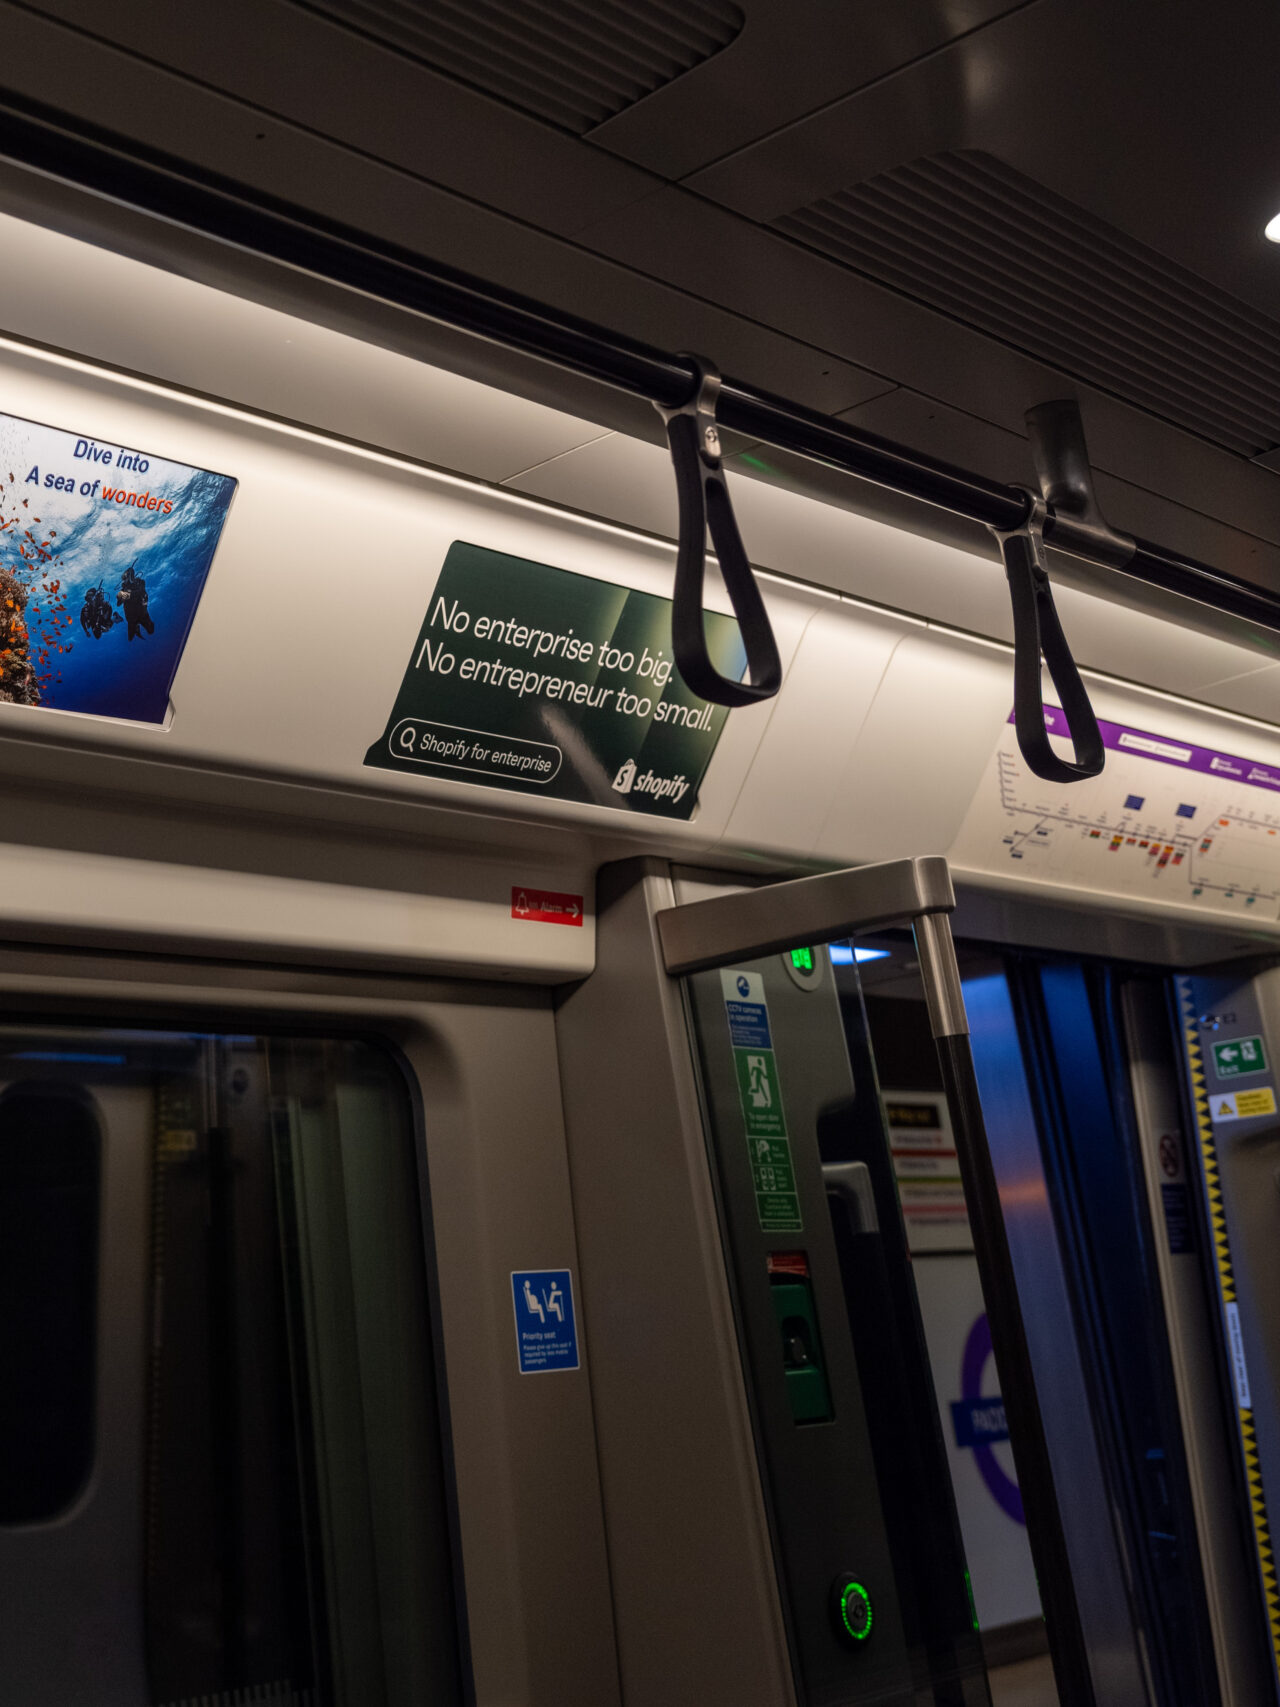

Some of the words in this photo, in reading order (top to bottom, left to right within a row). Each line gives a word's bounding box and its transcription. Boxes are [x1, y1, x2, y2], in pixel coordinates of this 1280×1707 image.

[73, 439, 113, 465] Dive
[116, 449, 150, 473] into
[25, 465, 39, 485] A
[44, 472, 75, 494] sea
[80, 479, 100, 498] of
[102, 485, 174, 515] wonders
[430, 596, 470, 634] No
[473, 616, 594, 663] enterprise
[597, 641, 634, 672] too
[636, 647, 673, 687] big.
[415, 638, 455, 675] No
[459, 657, 614, 709] entrepreneur
[616, 687, 652, 718] too
[654, 700, 714, 732] small.
[420, 733, 470, 760] Shopify
[471, 743, 490, 761] for
[491, 751, 552, 773] enterprise
[633, 769, 690, 804] shopify
[540, 901, 564, 913] Alarm
